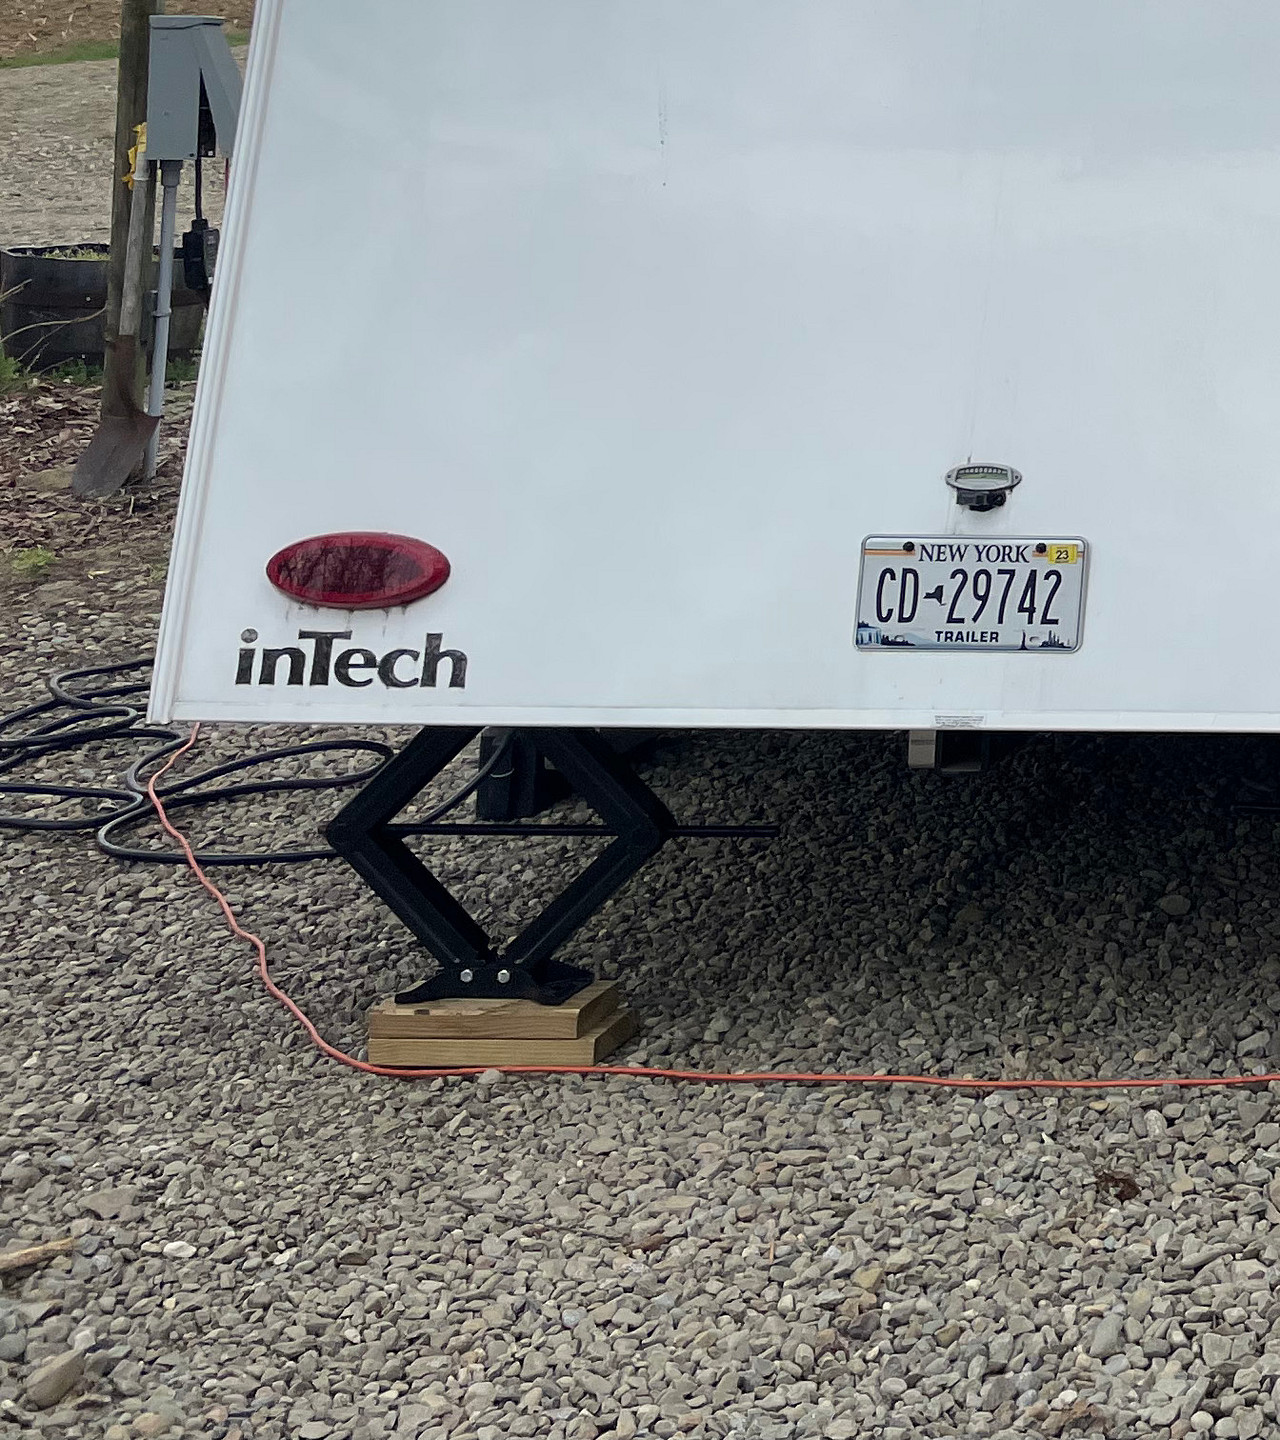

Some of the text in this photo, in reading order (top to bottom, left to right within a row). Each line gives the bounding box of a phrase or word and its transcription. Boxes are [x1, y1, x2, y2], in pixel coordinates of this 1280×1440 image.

[918, 544, 1031, 563] NEW YORK
[1055, 549, 1070, 560] 23
[876, 567, 1063, 626] CD 29742
[935, 630, 999, 643] TRAILER
[235, 628, 468, 689] inTech
